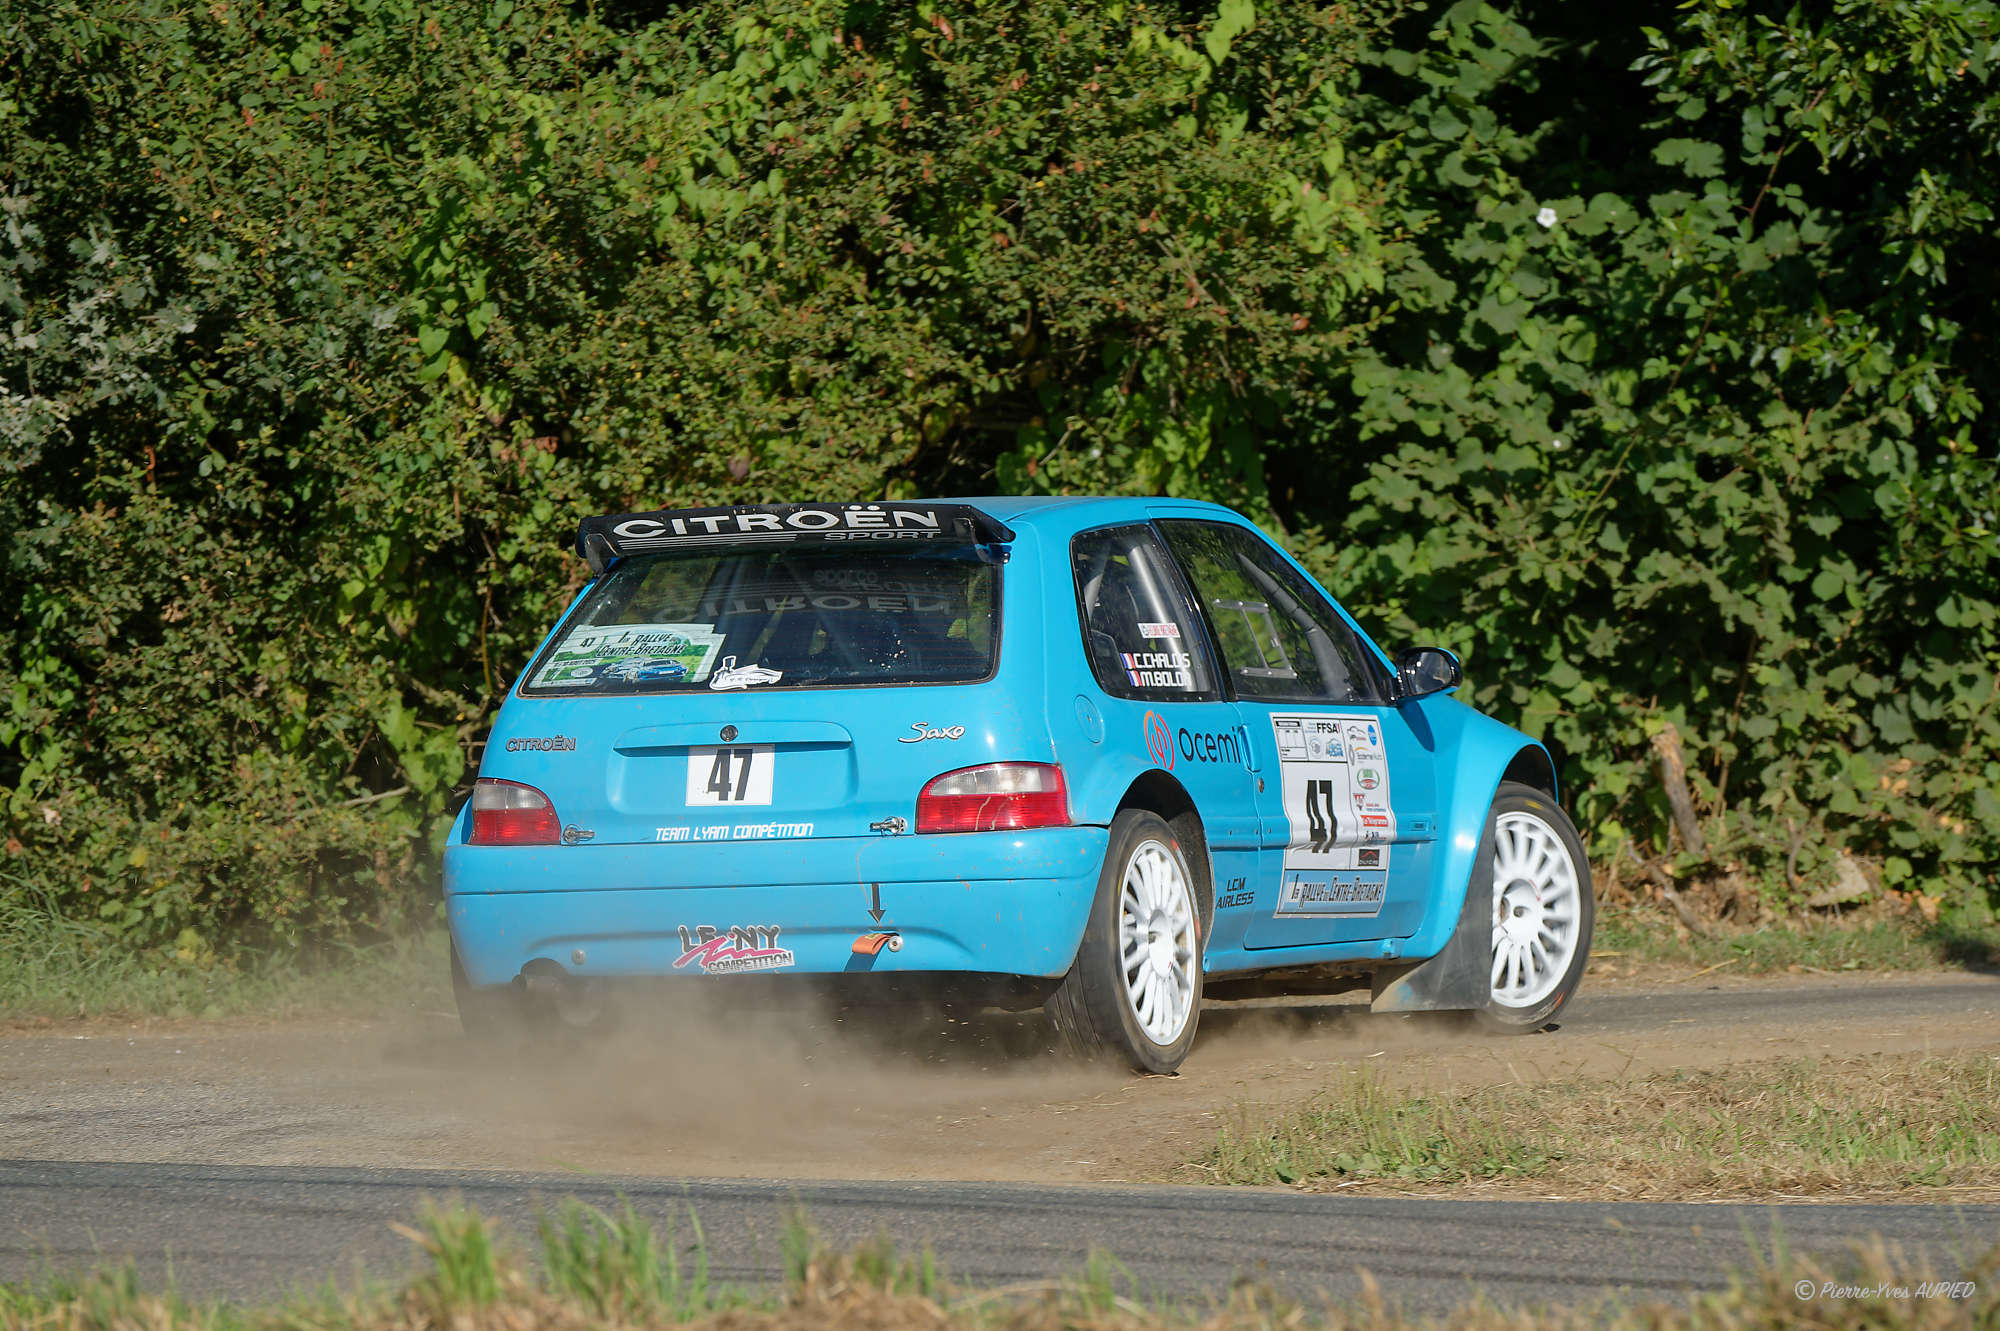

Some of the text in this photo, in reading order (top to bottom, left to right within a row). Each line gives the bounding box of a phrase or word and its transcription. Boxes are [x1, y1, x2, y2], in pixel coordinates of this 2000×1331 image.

[613, 505, 941, 538] CITROËN
[824, 531, 941, 541] SPORT
[580, 637, 596, 647] 47
[898, 722, 966, 743] Saxo
[1317, 722, 1338, 734] FFSA
[506, 735, 576, 752] CITROËN
[1178, 726, 1241, 763] Ocemi
[707, 749, 753, 801] 47
[1306, 780, 1338, 853] 47
[656, 822, 814, 841] TEAM LYAM COMPÉTITION
[1227, 877, 1247, 892] LCM
[1216, 892, 1255, 909] AIRLESS
